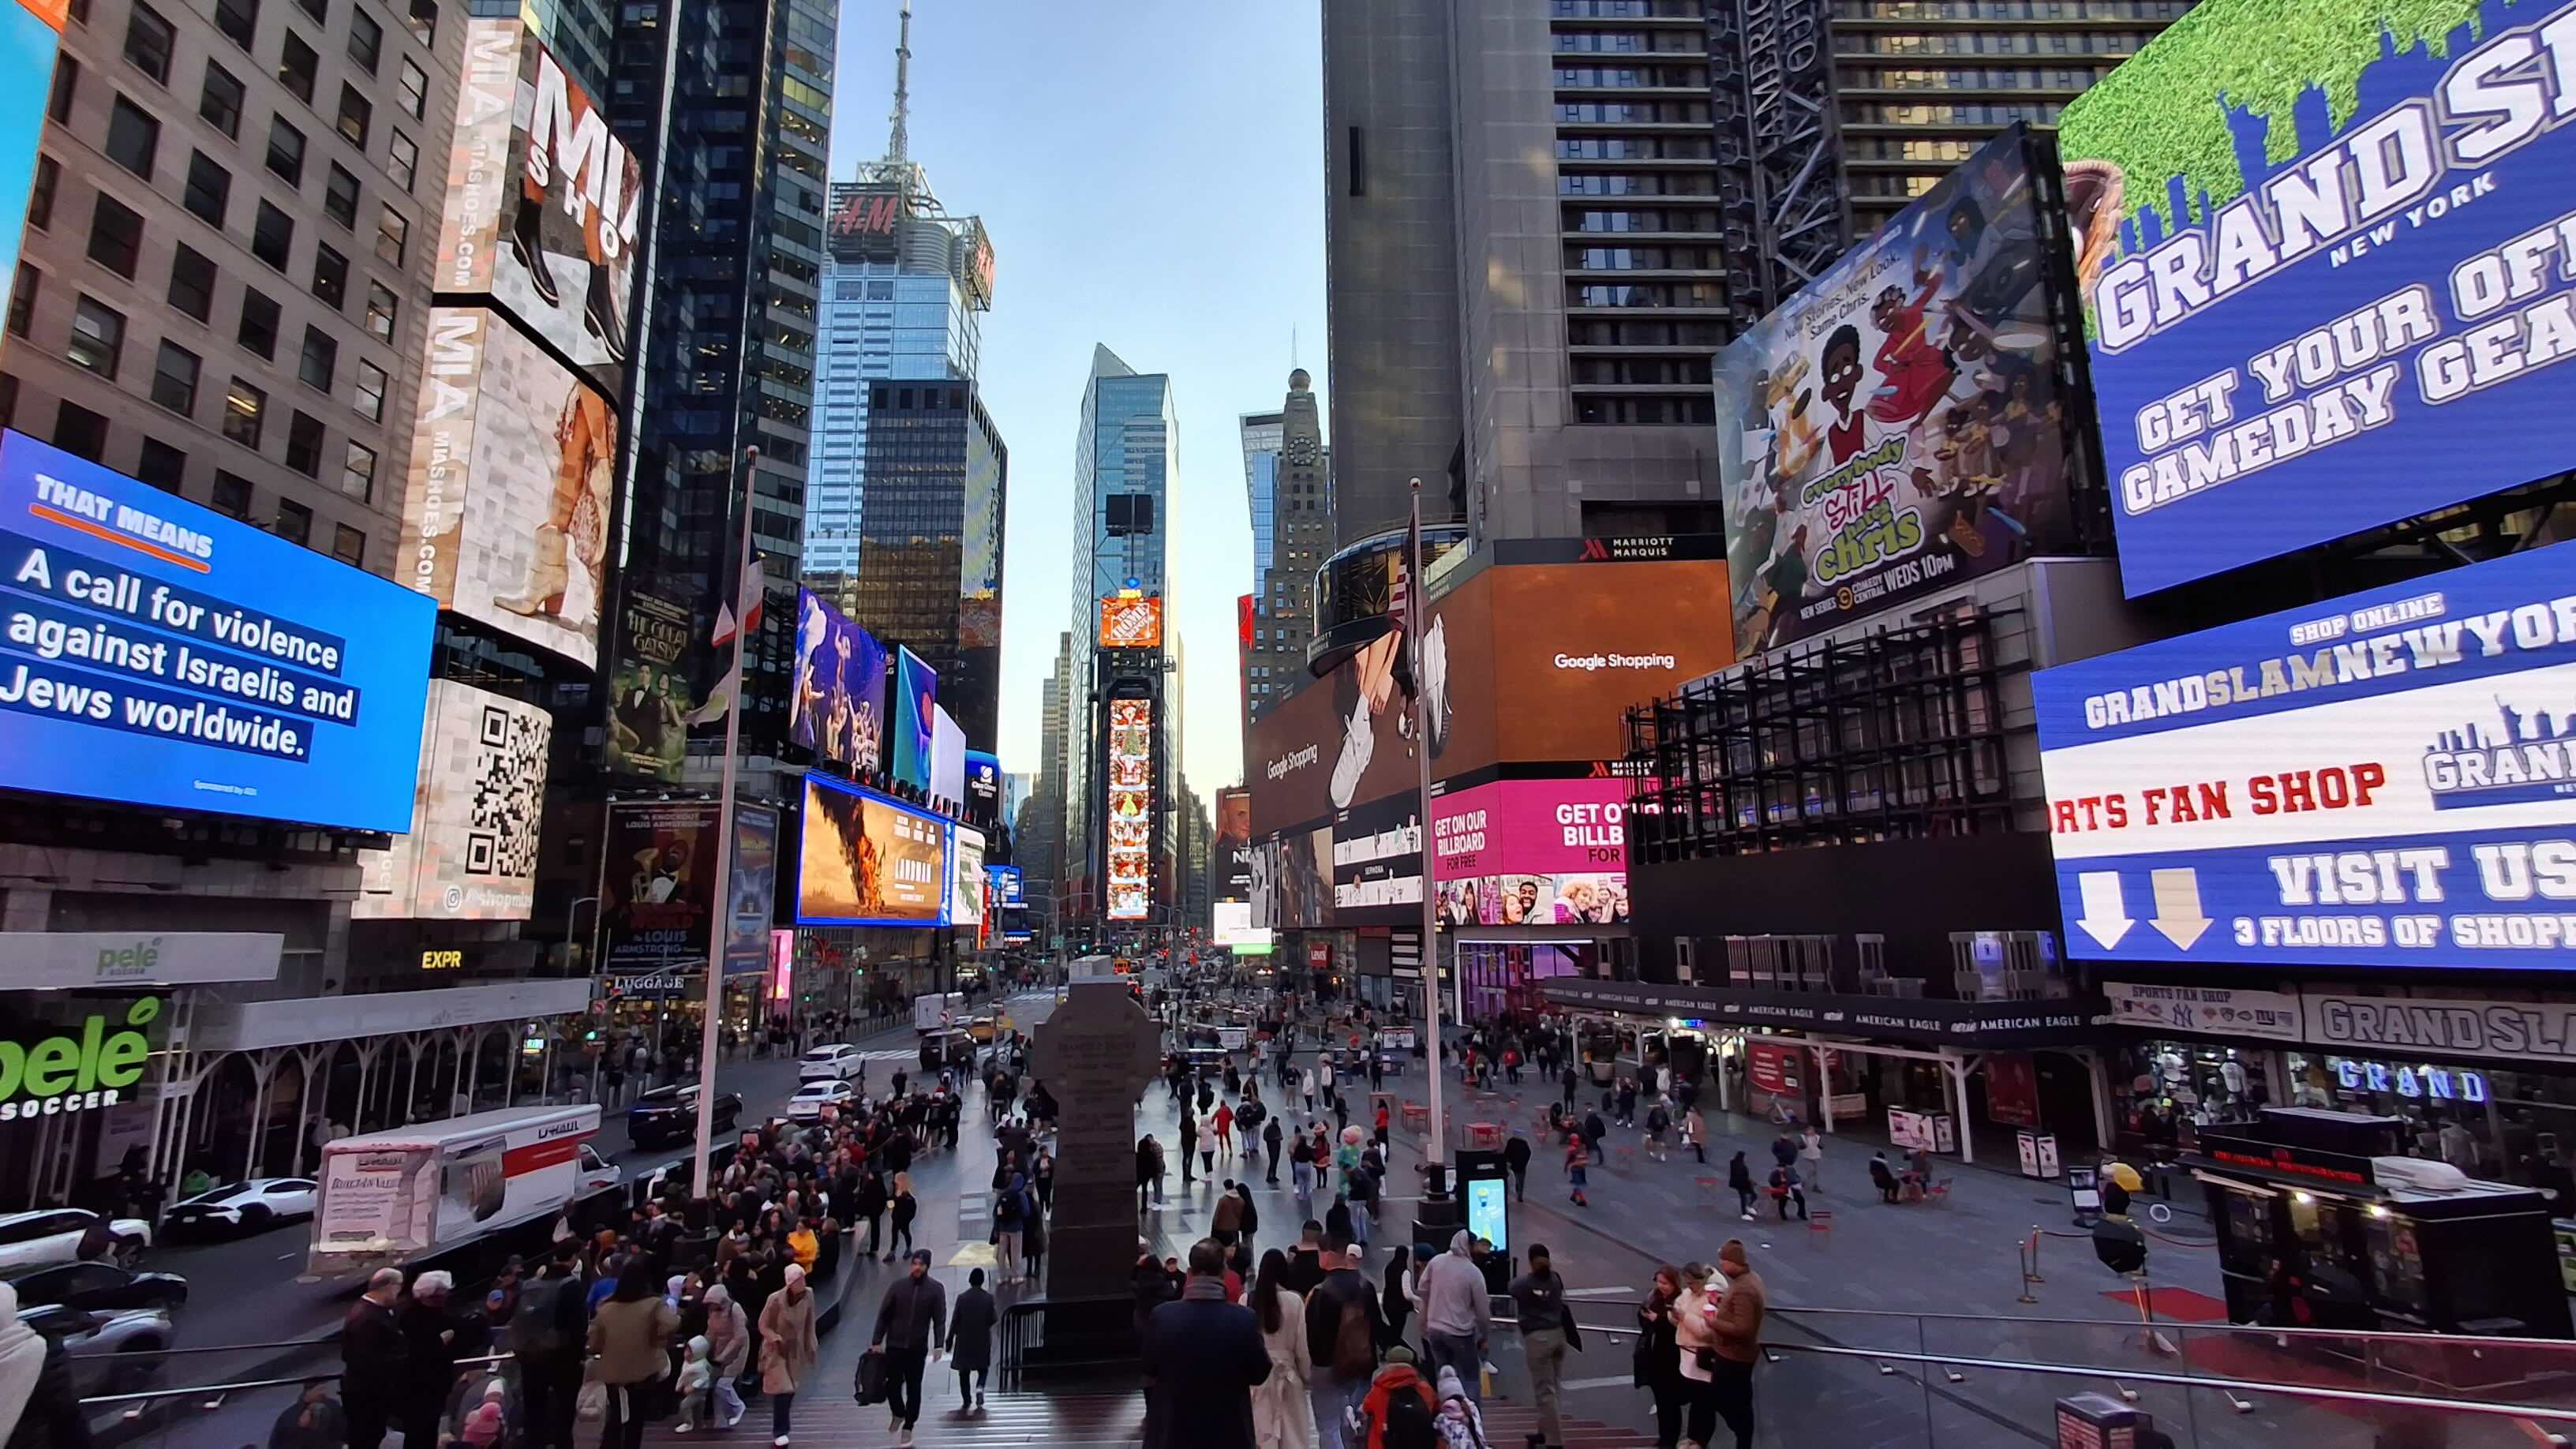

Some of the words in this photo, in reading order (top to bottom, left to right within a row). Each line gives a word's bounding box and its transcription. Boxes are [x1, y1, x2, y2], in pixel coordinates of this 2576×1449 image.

[459, 29, 515, 128] MIA
[833, 196, 897, 234] H&M
[2330, 228, 2394, 268] NEW
[2406, 170, 2499, 229] YORK
[1845, 274, 1869, 295] New
[1870, 252, 1900, 279] Look.
[1810, 314, 1837, 340] Same
[1839, 294, 1870, 320] Chris.
[413, 315, 479, 425] MIA
[2136, 367, 2238, 455] GET
[2250, 283, 2440, 405] YOUR
[2123, 361, 2399, 515] GAMEDAY
[36, 474, 113, 522] THAT
[117, 506, 214, 559] MEANS
[414, 430, 450, 593] MIASHOES.COM
[1613, 537, 1674, 546] MARRIOTT
[1614, 548, 1668, 556] MARQUIS
[1852, 573, 1883, 594] COMEDY
[1884, 560, 1921, 593] WEDS
[1922, 554, 1955, 579] 10PM
[17, 549, 52, 590] A
[66, 567, 141, 614] call
[152, 586, 205, 631] for
[213, 611, 339, 670] violence
[1854, 587, 1887, 605] CENTRAL
[1112, 605, 1148, 638] HOME
[1800, 607, 1814, 620] NEW
[2290, 616, 2347, 646] SHOP
[2352, 593, 2444, 632] ONLINE
[10, 612, 167, 676] against
[176, 647, 296, 706] Israelis
[301, 687, 354, 721] and
[1553, 653, 1606, 671] Google
[1608, 653, 1675, 670] Shopping
[0, 665, 113, 718] Jews
[125, 697, 305, 757] worldwide.
[1268, 754, 1289, 780] Google
[1288, 743, 1318, 770] Shopping
[2424, 738, 2576, 792] GRAN
[2145, 781, 2232, 826] FAN
[2248, 762, 2386, 815] SHOP
[1436, 816, 1451, 837] GET
[1452, 813, 1466, 833] ON
[1467, 809, 1487, 829] OUR
[1556, 803, 1601, 824] GET
[1437, 832, 1485, 856] BILLBOARD
[1588, 848, 1620, 863] FOR
[1446, 856, 1459, 871] FOR
[1460, 854, 1477, 869] FREE
[2268, 847, 2447, 905] VISIT
[2471, 840, 2576, 901] US
[645, 930, 687, 942] LOUIS
[2233, 916, 2257, 945] 3
[2261, 915, 2386, 947] FLOORS
[2392, 915, 2442, 947] OF
[421, 950, 462, 969] EXPR
[614, 944, 683, 954] ARMSTRONG
[1664, 998, 1694, 1009] AMERICAN
[1697, 1002, 1717, 1011] EAGLE
[2132, 987, 2173, 999] SPORTS
[2177, 989, 2198, 1001] FAN
[2202, 990, 2232, 1002] SHOP
[1748, 1005, 1787, 1016] AMERICAN
[1789, 1007, 1814, 1018] EAGLE
[1855, 1014, 1904, 1028] AMERICAN
[1910, 1019, 1941, 1031] EAGLE
[1980, 1018, 2040, 1030] AMERICAN
[2046, 1016, 2080, 1027] EAGLE
[2338, 1060, 2486, 1103] GRAND
[0, 1089, 119, 1121] SOCCER
